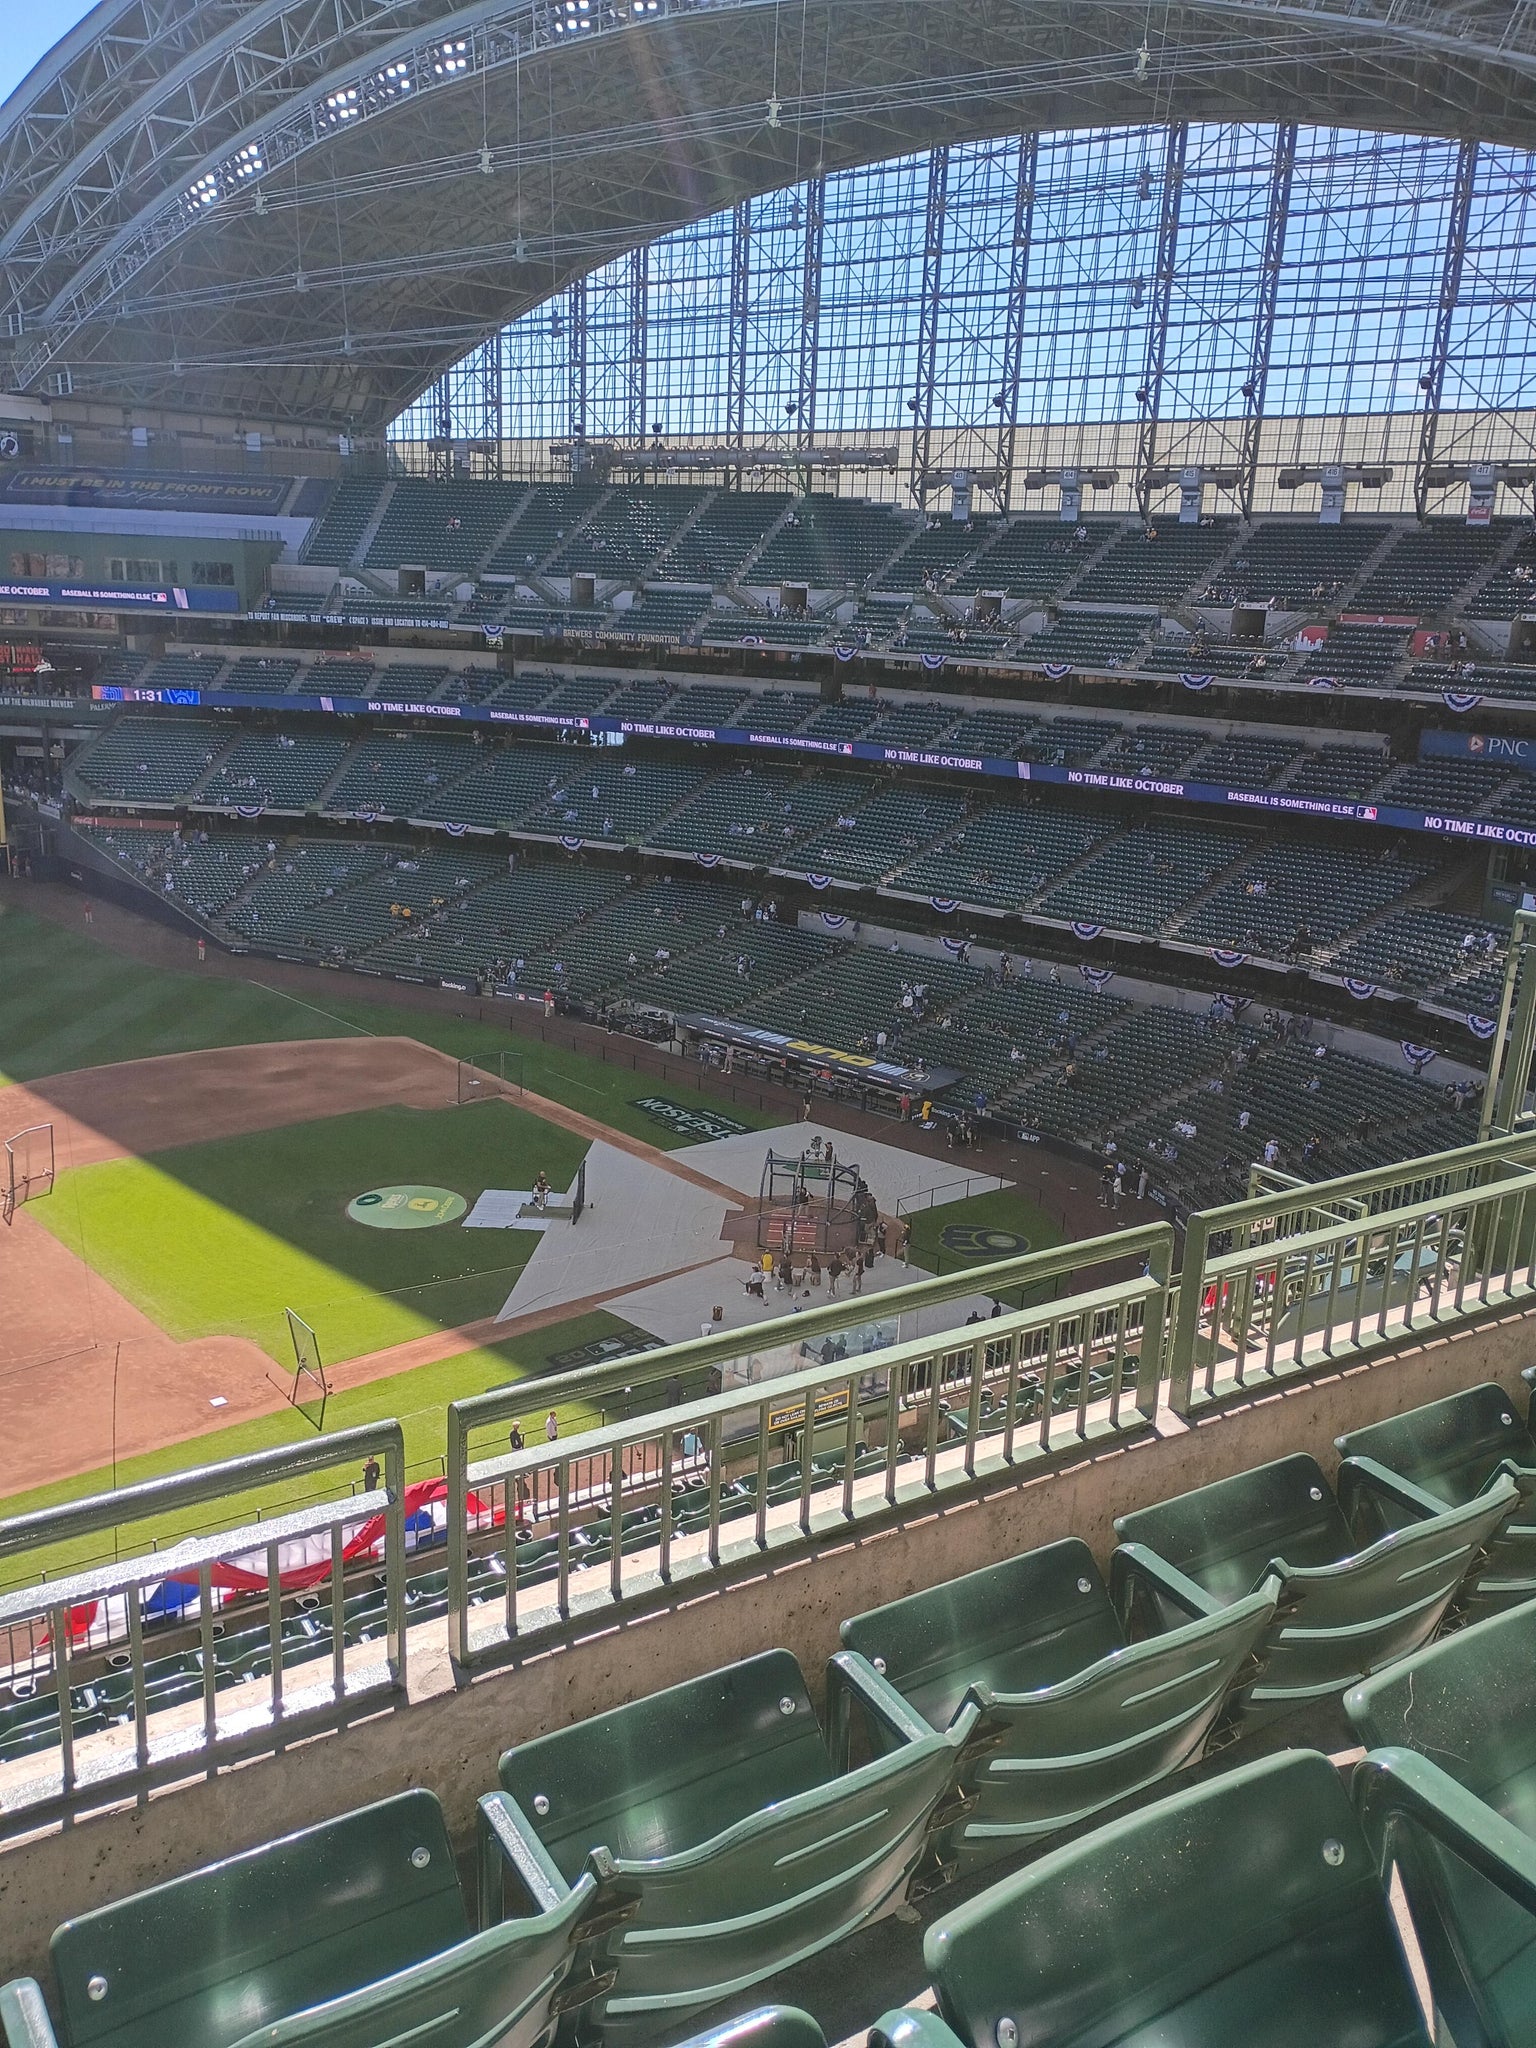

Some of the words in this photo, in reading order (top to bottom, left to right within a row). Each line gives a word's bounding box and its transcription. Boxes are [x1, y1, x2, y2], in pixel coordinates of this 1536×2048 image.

[1327, 468, 1339, 477] 416
[1477, 466, 1489, 474] 417
[31, 477, 79, 487] MUST
[81, 478, 104, 487] BE
[106, 480, 125, 488] IN
[130, 481, 163, 491] THE
[165, 483, 223, 494] FRONT
[224, 486, 273, 497] ROW!
[11, 586, 50, 597] OCTOBER
[61, 589, 92, 598] BASEBALL
[100, 591, 135, 600] SOMETHING
[254, 612, 270, 620] REPORT
[310, 614, 321, 622] TEXT
[385, 617, 393, 626] AND
[394, 618, 414, 627] LOCATION
[563, 629, 593, 639] BREWERS
[595, 631, 635, 641] COMMUNITY
[638, 633, 680, 644] FOUNDATION
[133, 690, 162, 701] 1:31
[368, 702, 381, 711] NO
[382, 703, 404, 712] TIME
[405, 704, 426, 714] LIKE
[426, 705, 461, 716] OCTOBER
[490, 711, 518, 720] BASEBALL
[525, 714, 559, 723] SOMETHING
[560, 717, 574, 725] ELSE
[621, 722, 633, 731] NO
[634, 723, 654, 733] TIME
[655, 725, 674, 736] LIKE
[675, 727, 716, 739] OCTOBER
[750, 734, 782, 744] BASEBALL
[783, 736, 789, 744] IS
[789, 738, 822, 749] SOMETHING
[823, 741, 838, 750] ELSE
[1488, 737, 1529, 757] PNC
[884, 749, 897, 759] NO
[898, 750, 919, 762] TIME
[920, 753, 940, 765] LIKE
[941, 756, 982, 770] OCTOBER
[1068, 771, 1082, 782] NO
[1083, 773, 1108, 786] TIME
[1109, 776, 1133, 789] LIKE
[1134, 779, 1185, 796] OCTOBER
[1227, 792, 1269, 805] BASEBALL
[1270, 795, 1278, 806] IS
[1279, 798, 1331, 813] SOMETHING
[1332, 804, 1355, 816] ELSE
[1424, 816, 1442, 829] NO
[1443, 819, 1474, 835] TIME
[1475, 823, 1505, 840] LIKE
[786, 1040, 876, 1067] OUR
